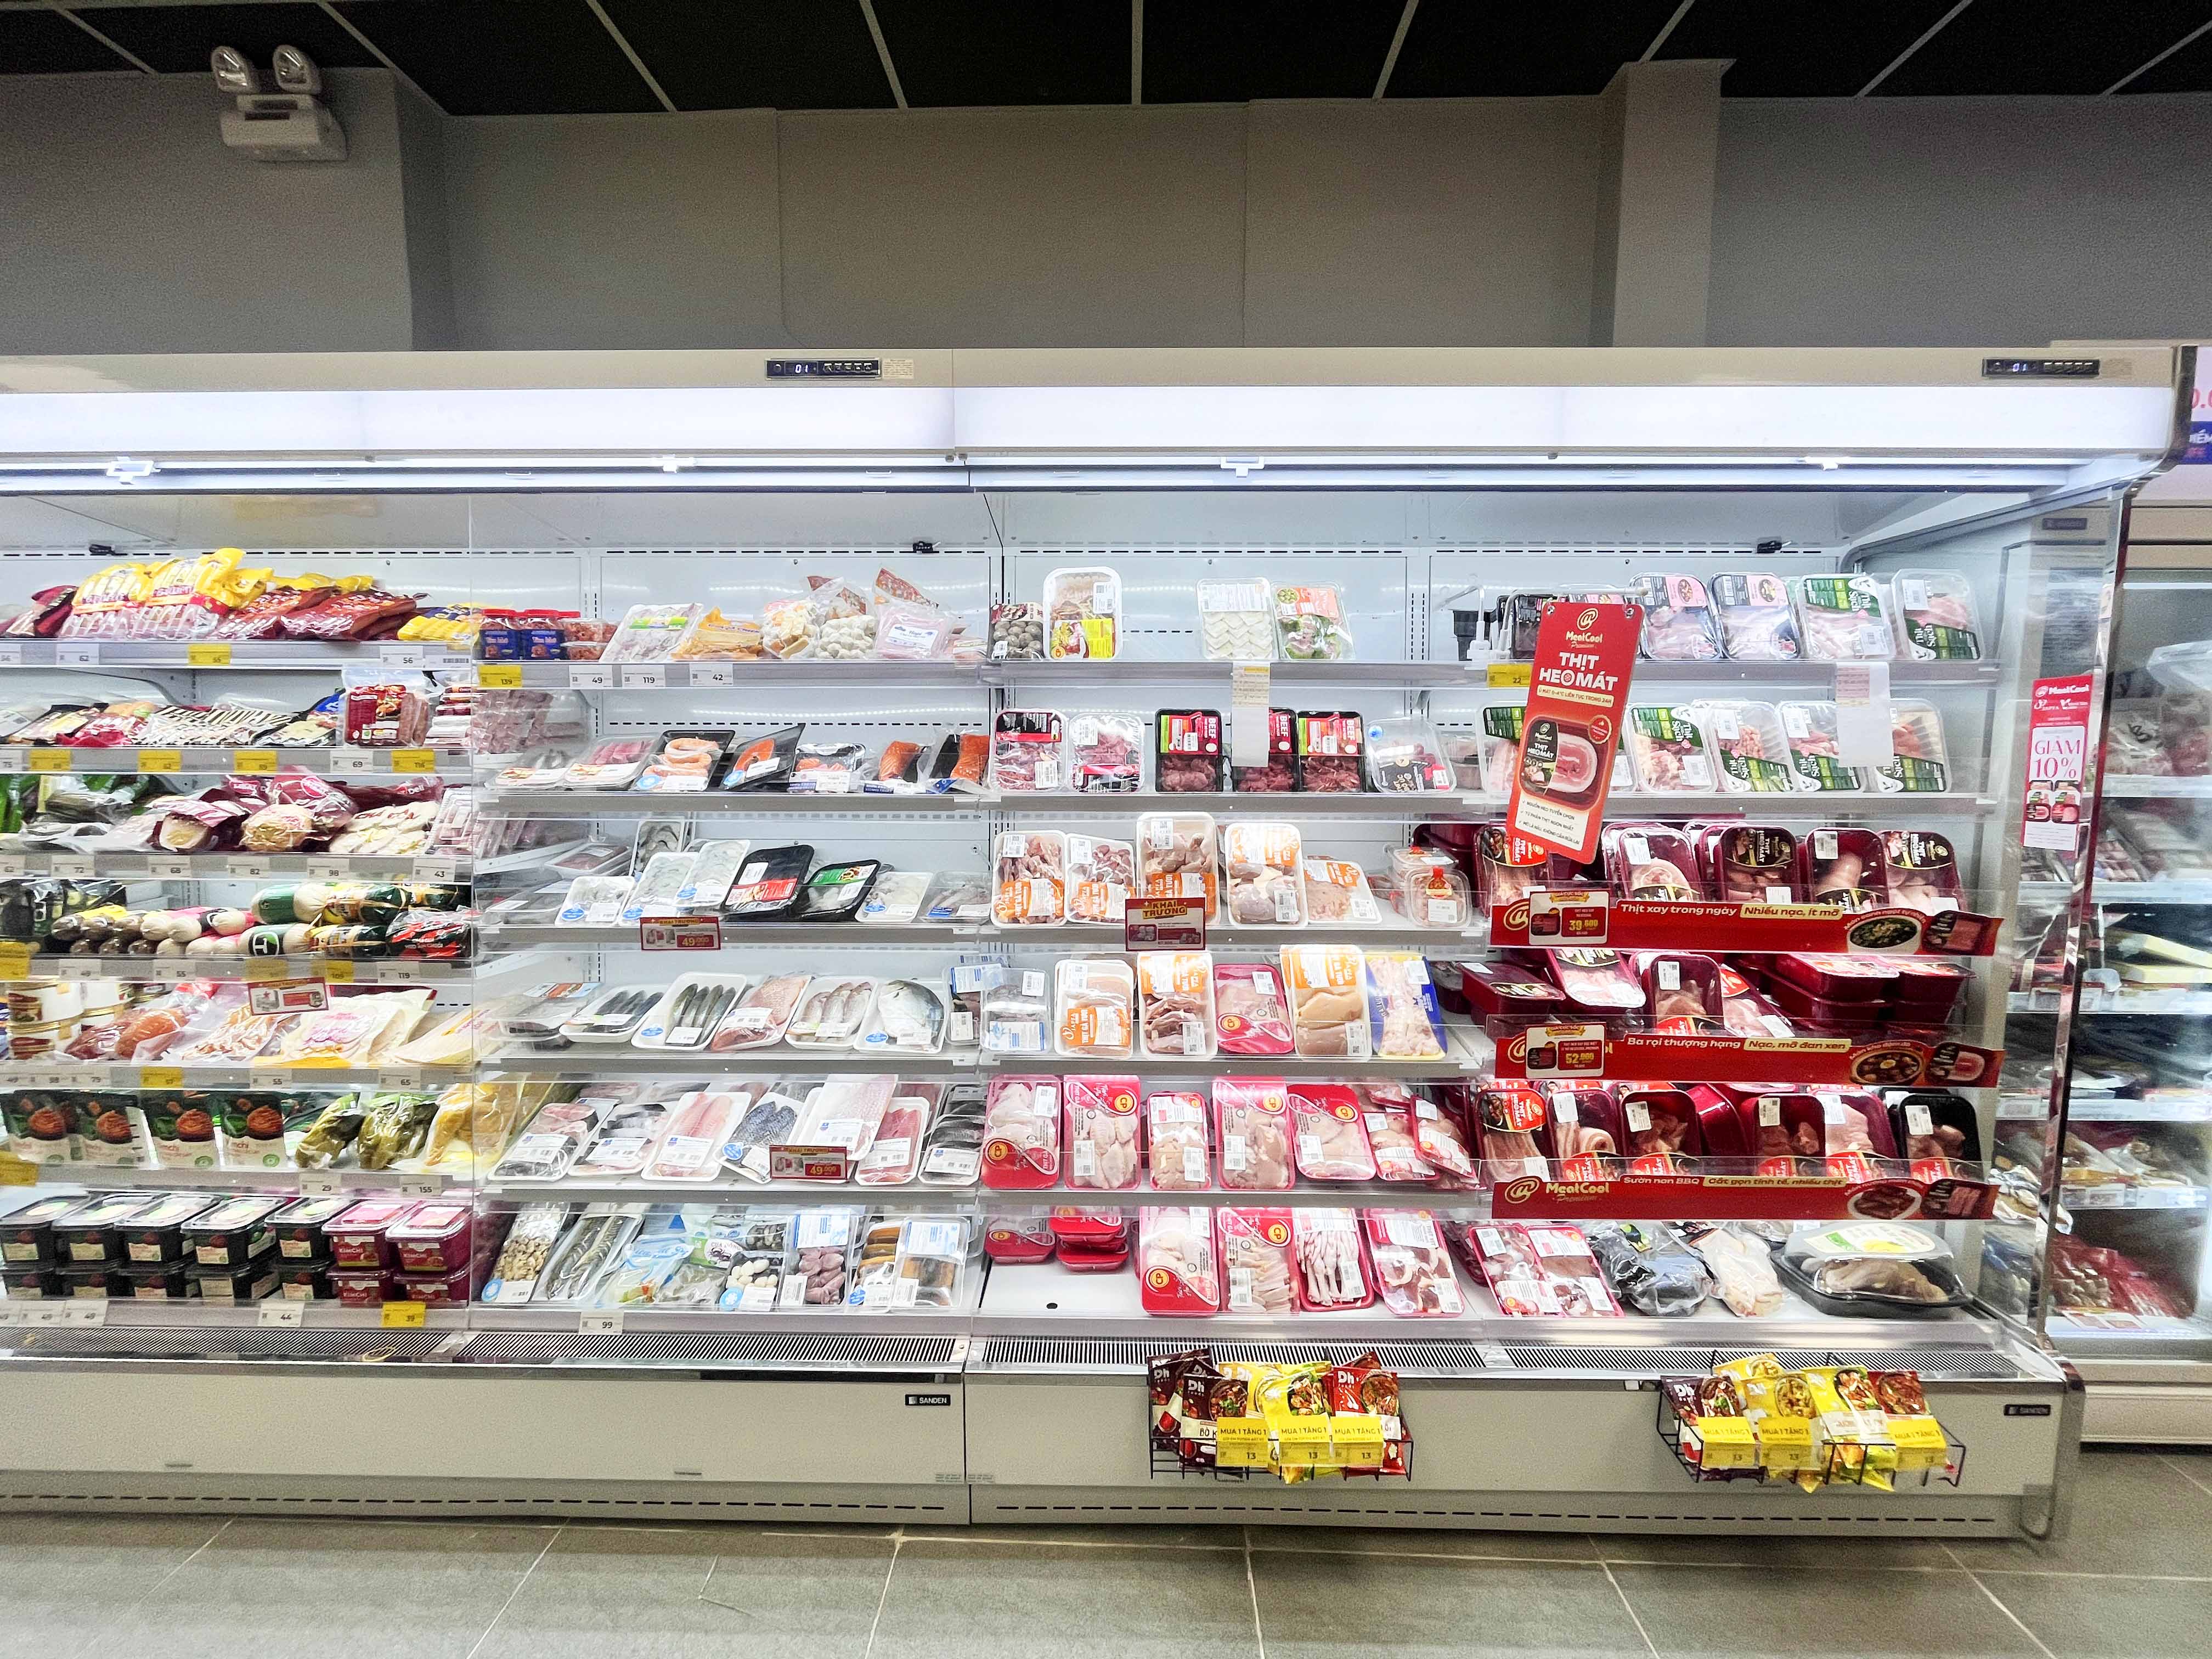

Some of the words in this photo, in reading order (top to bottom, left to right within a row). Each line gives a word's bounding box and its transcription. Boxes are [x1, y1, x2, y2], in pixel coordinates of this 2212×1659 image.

[795, 364, 809, 373] 01
[1566, 631, 1603, 643] MeatCool
[1559, 652, 1599, 671] THỊT
[1539, 668, 1575, 686] HEO
[1576, 671, 1618, 691] MÁT
[1280, 716, 1288, 737] BEEF
[1346, 719, 1355, 741] BEEF
[1672, 720, 1683, 742] Sạch
[1681, 723, 1693, 739] Thịt
[1729, 759, 1740, 775] Thịt
[1738, 757, 1750, 778] Sạch
[1799, 758, 1809, 775] Thịt
[1807, 755, 1821, 777] Sạch
[2034, 758, 2077, 778] 10%
[1153, 900, 1177, 910] KHAI
[1621, 904, 1644, 915] Thịt
[1646, 906, 1669, 915] xay
[1671, 906, 1704, 915] trong
[1705, 906, 1737, 916] ngày
[1780, 909, 1805, 918] nạc,
[1143, 907, 1186, 917] TRƯƠNG
[1628, 1037, 1644, 1045] Ba
[1645, 1038, 1662, 1048] rọi
[1664, 1039, 1707, 1048] thượng
[1709, 1040, 1741, 1049] hạng
[1120, 1097, 1127, 1108] CP
[1268, 1097, 1277, 1108] CP
[1340, 1108, 1348, 1117] CP
[994, 1145, 1002, 1157] CP
[810, 1166, 836, 1175] 49.000
[1545, 1182, 1610, 1194] MeatCool
[1273, 1228, 1282, 1240] CP
[1156, 1272, 1164, 1284] CP
[1154, 1368, 1170, 1379] Dh
[1338, 1371, 1355, 1384] Dh
[1188, 1380, 1205, 1392] Dh
[1673, 1384, 1695, 1397] Dh
[1200, 1427, 1210, 1436] BÒ
